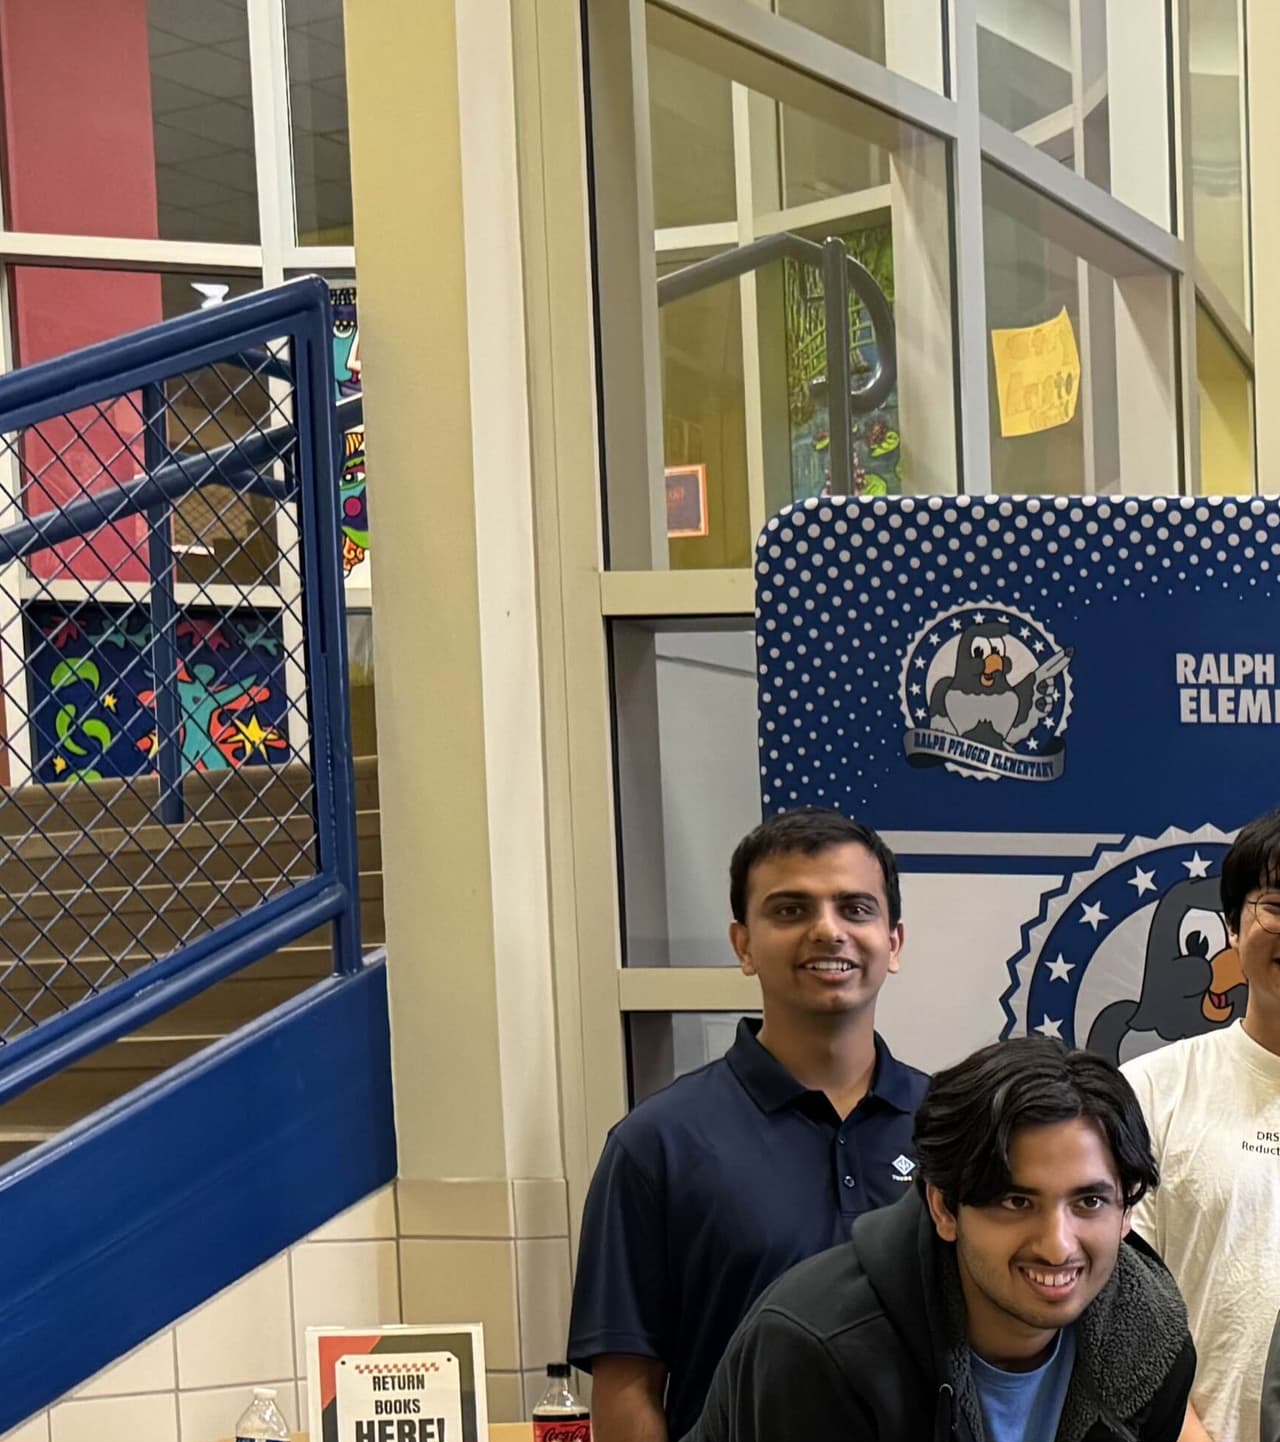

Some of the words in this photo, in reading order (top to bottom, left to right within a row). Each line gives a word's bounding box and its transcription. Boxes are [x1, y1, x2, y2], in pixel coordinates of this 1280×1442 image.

[1176, 653, 1275, 684] RALPH
[914, 732, 947, 748] RALPH
[949, 742, 990, 765] PFLUGER
[992, 754, 1055, 778] ELEMENTARY
[1256, 1131, 1280, 1142] DRS
[372, 1374, 425, 1392] RETURN
[374, 1399, 421, 1415] BOOKS
